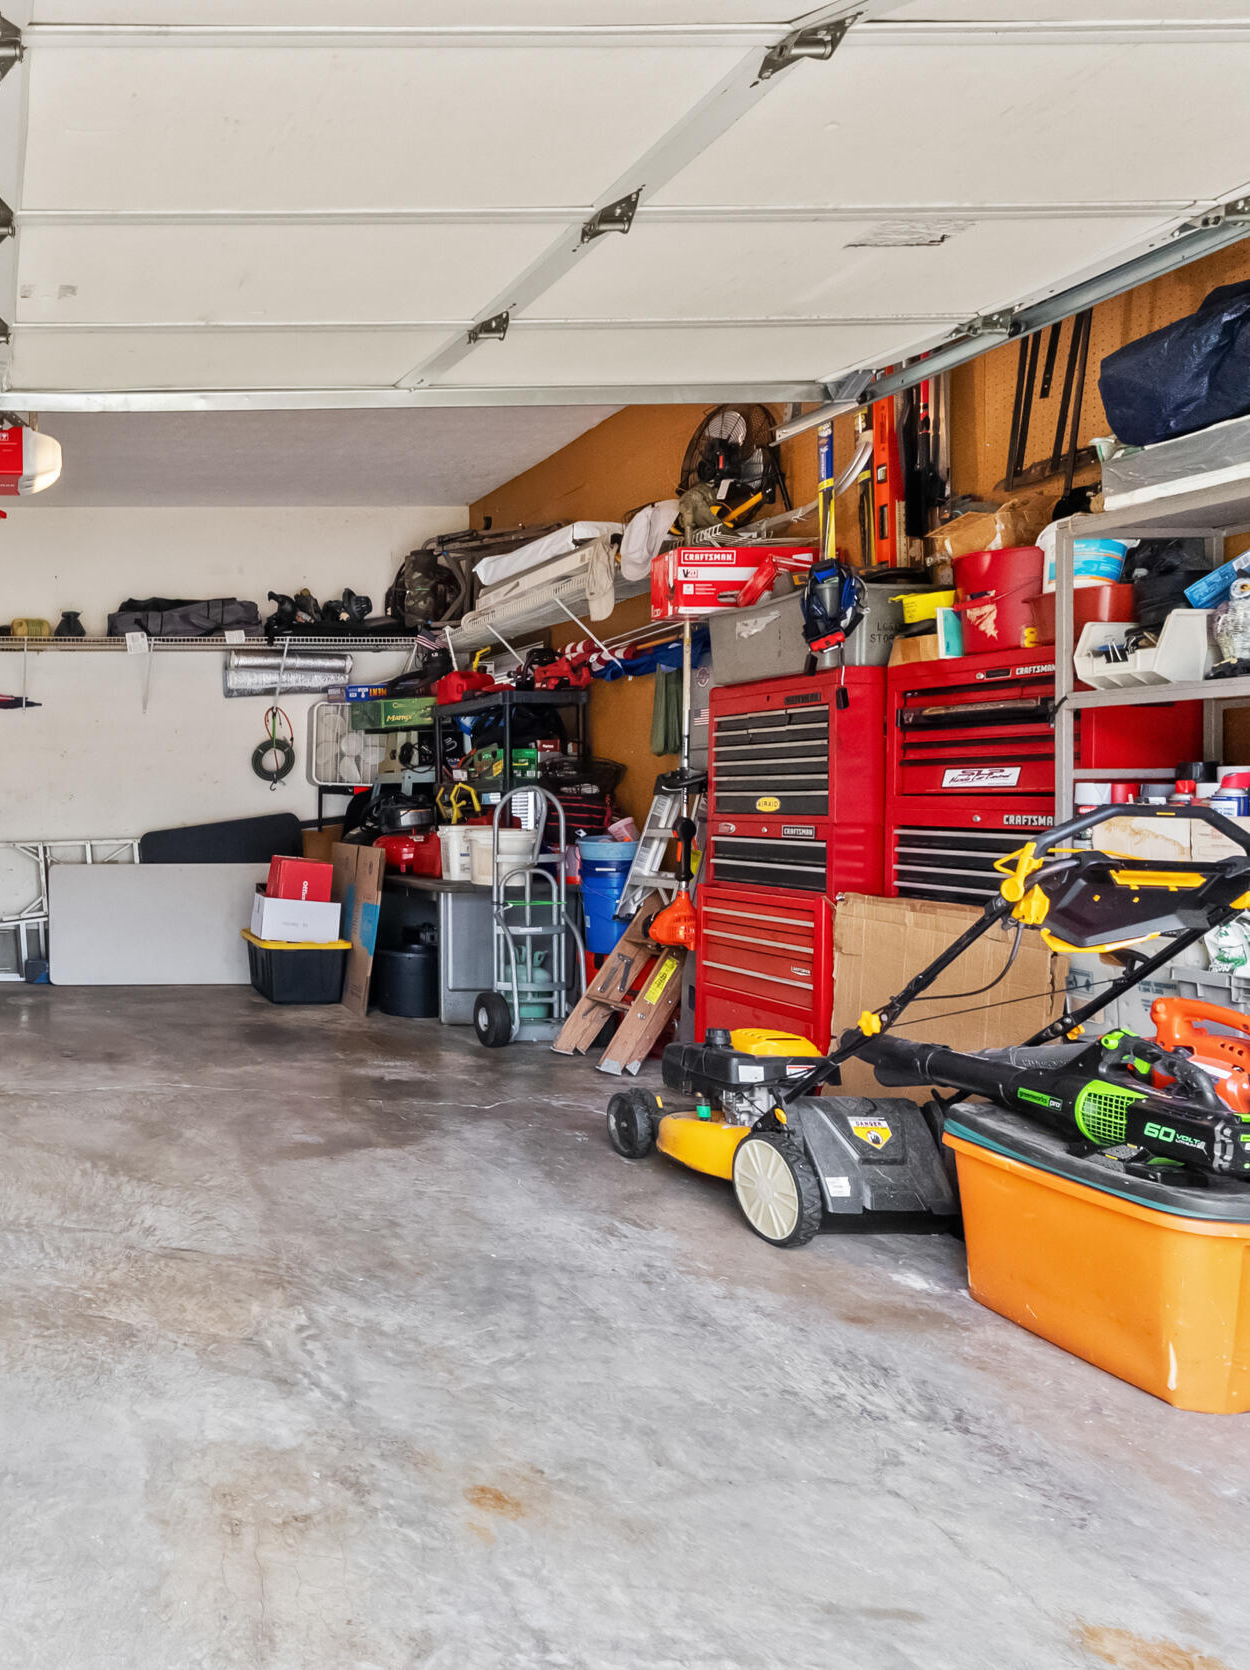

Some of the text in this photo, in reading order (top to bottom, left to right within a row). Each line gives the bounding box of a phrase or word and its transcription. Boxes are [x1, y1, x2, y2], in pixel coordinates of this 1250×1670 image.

[684, 553, 733, 561] CRAFTSMAN
[1003, 814, 1054, 827] CRAFTSMA
[783, 827, 813, 836] CRAFTSMAN
[1143, 1121, 1202, 1145] 60 VOLT
